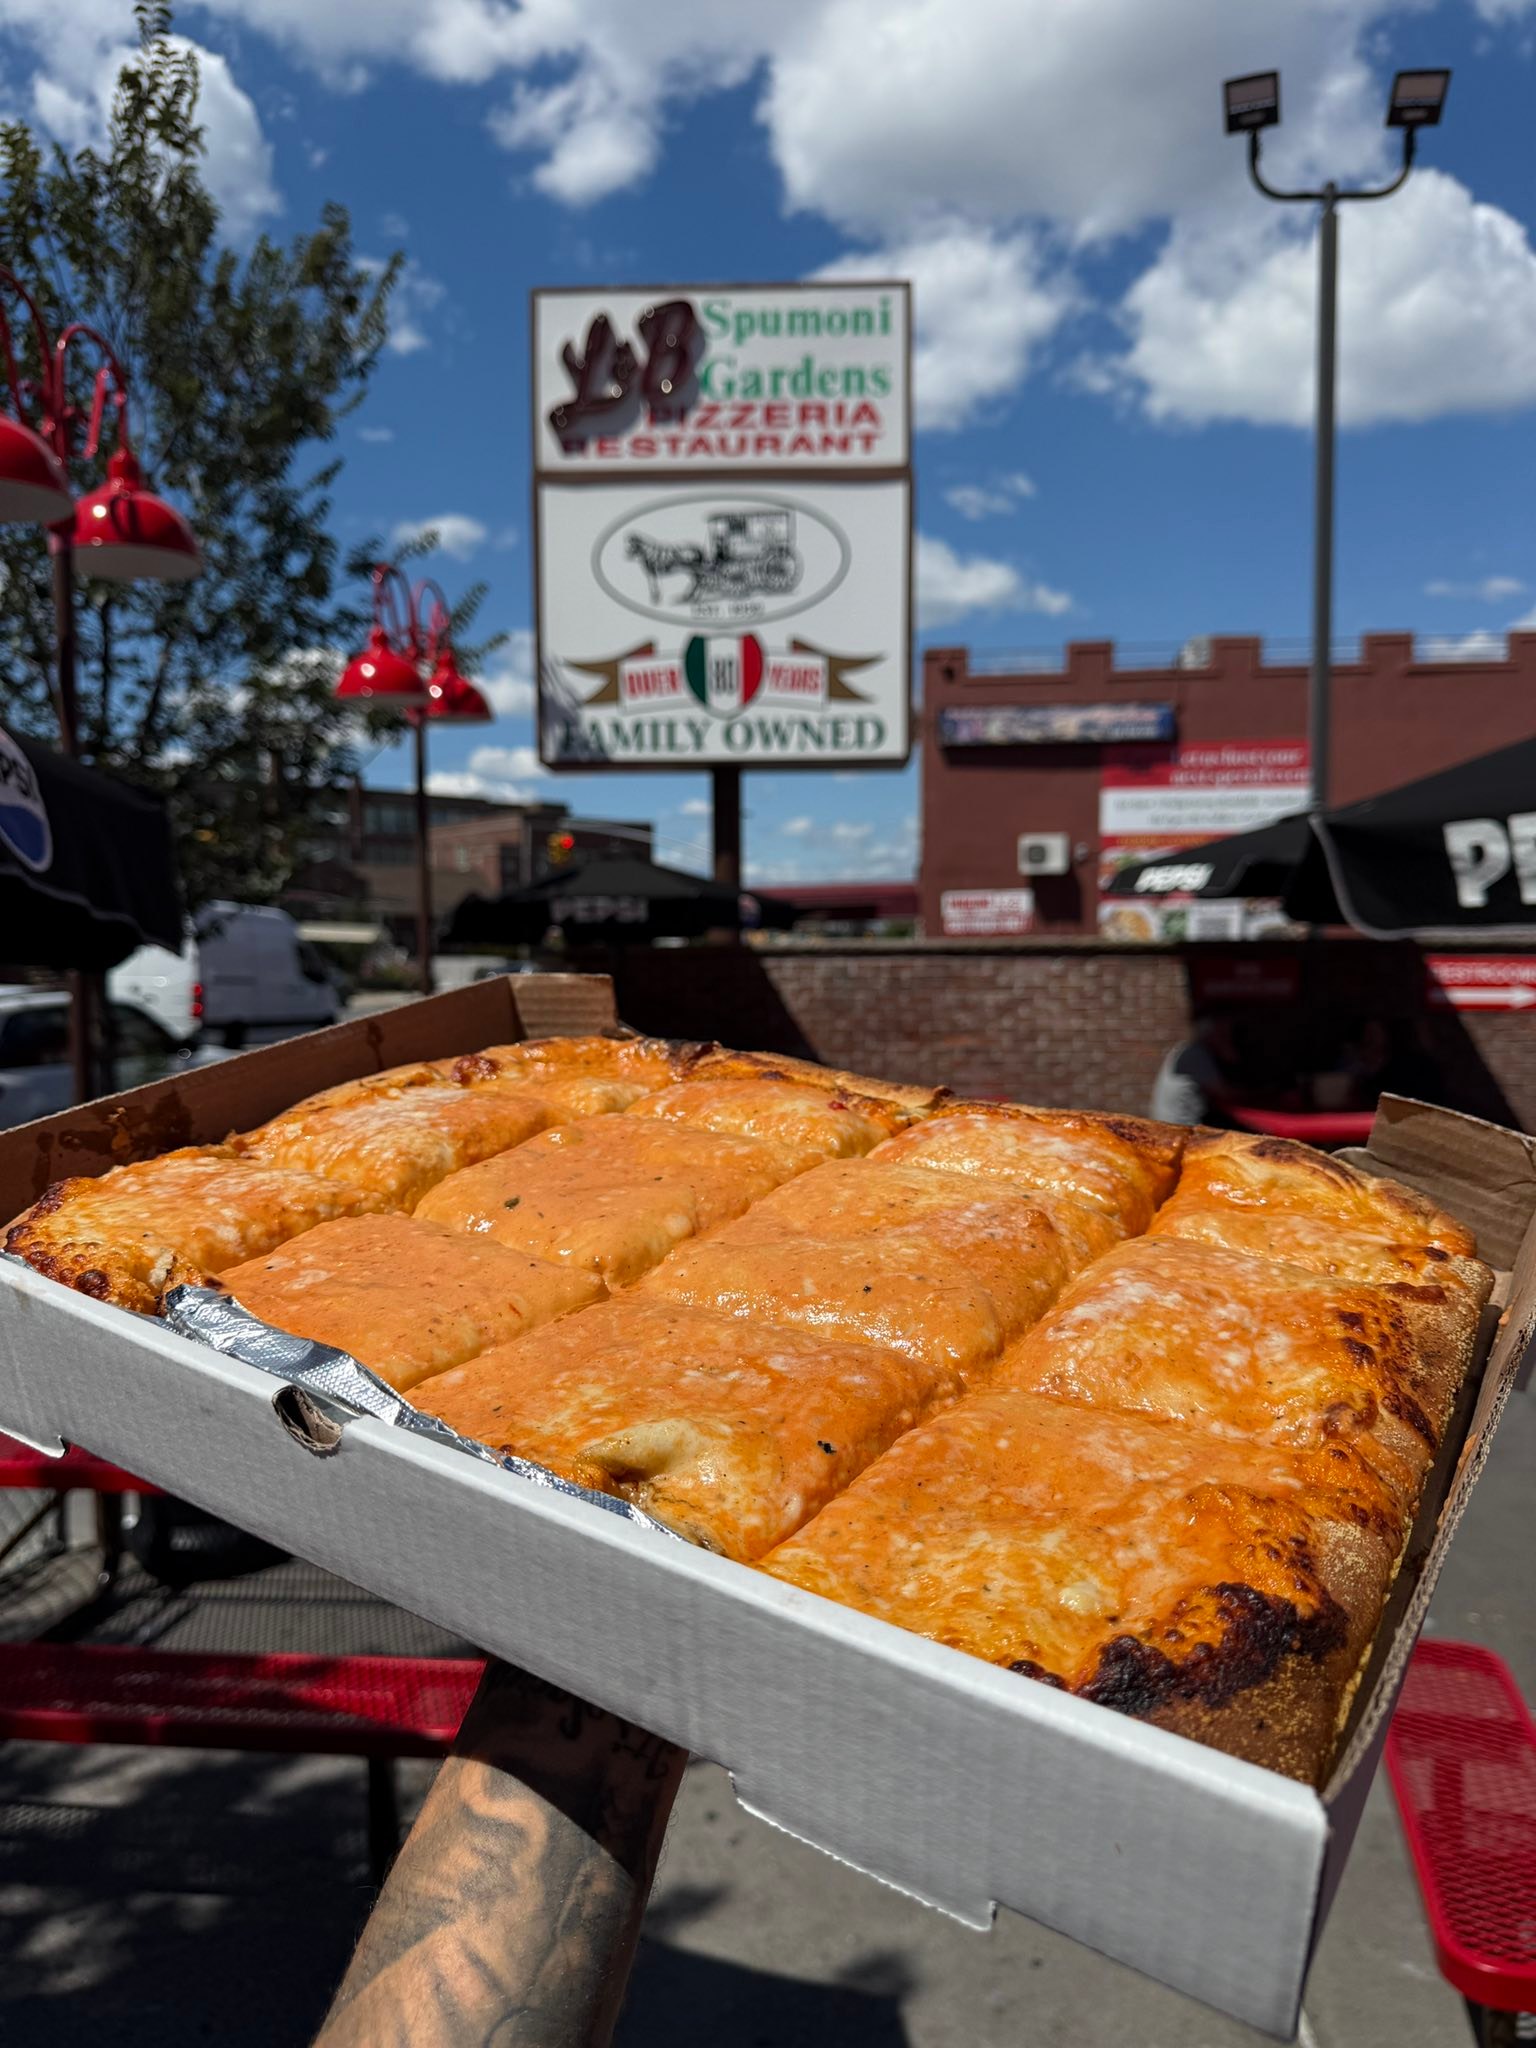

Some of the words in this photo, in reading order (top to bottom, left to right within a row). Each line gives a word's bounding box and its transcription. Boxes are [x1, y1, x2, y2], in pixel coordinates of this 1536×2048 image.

[703, 298, 892, 344] Spumoni
[699, 355, 892, 400] Gardens
[624, 667, 681, 698] OVER
[766, 663, 821, 694] YEARS
[563, 719, 711, 753] FAMILY
[723, 716, 886, 753] OWNED
[1134, 863, 1214, 893] PEPSI
[550, 897, 648, 924] PEPSI
